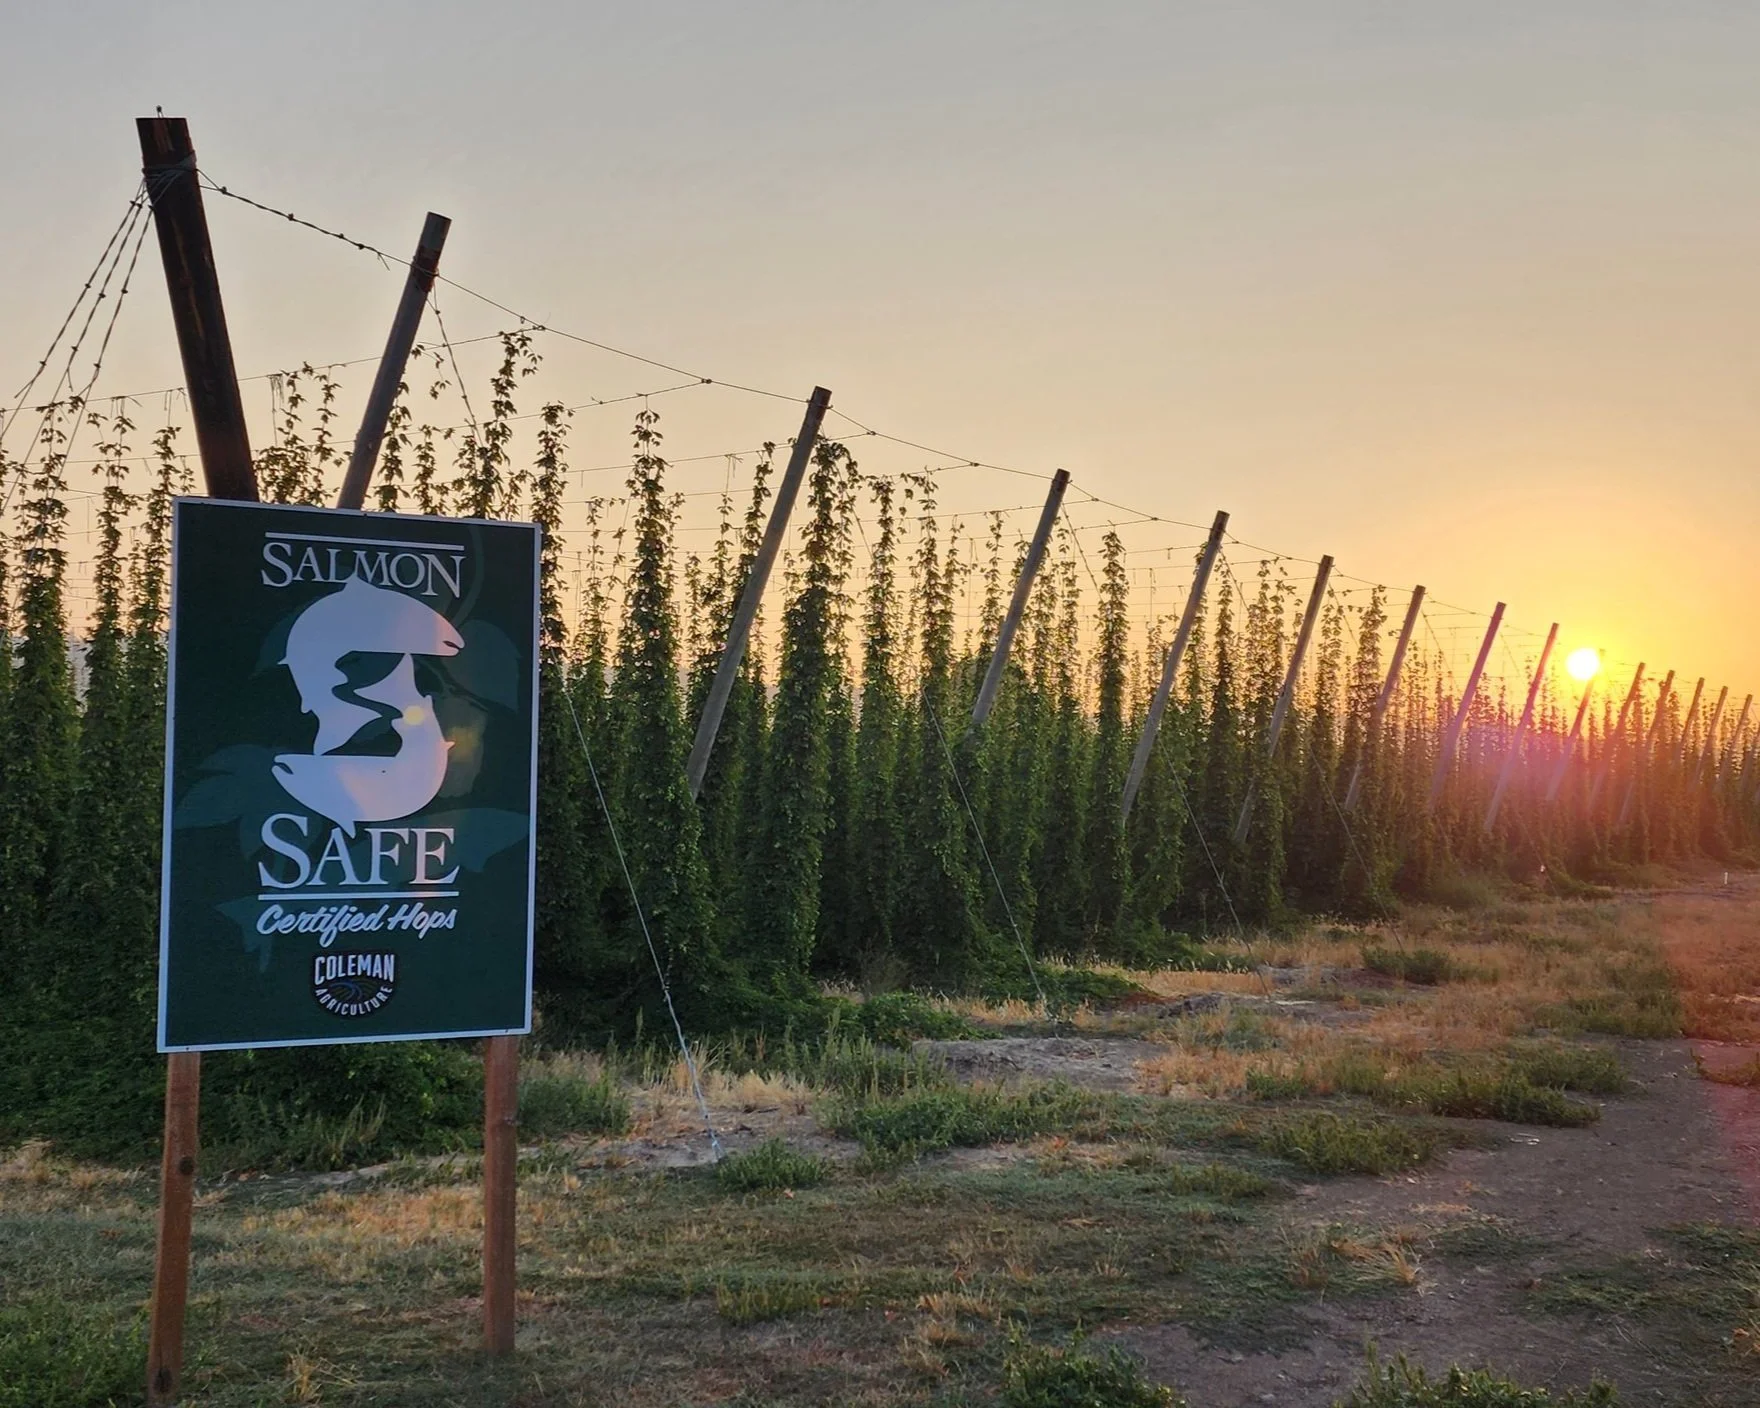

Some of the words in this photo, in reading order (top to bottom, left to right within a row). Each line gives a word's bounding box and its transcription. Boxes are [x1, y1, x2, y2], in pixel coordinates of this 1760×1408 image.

[261, 542, 466, 598] SALMON
[258, 813, 459, 889] SAFE
[256, 904, 389, 948] Certified
[387, 902, 457, 939] Hops
[314, 954, 395, 985] COLEMAN
[315, 986, 393, 1015] AGRICULTURE
